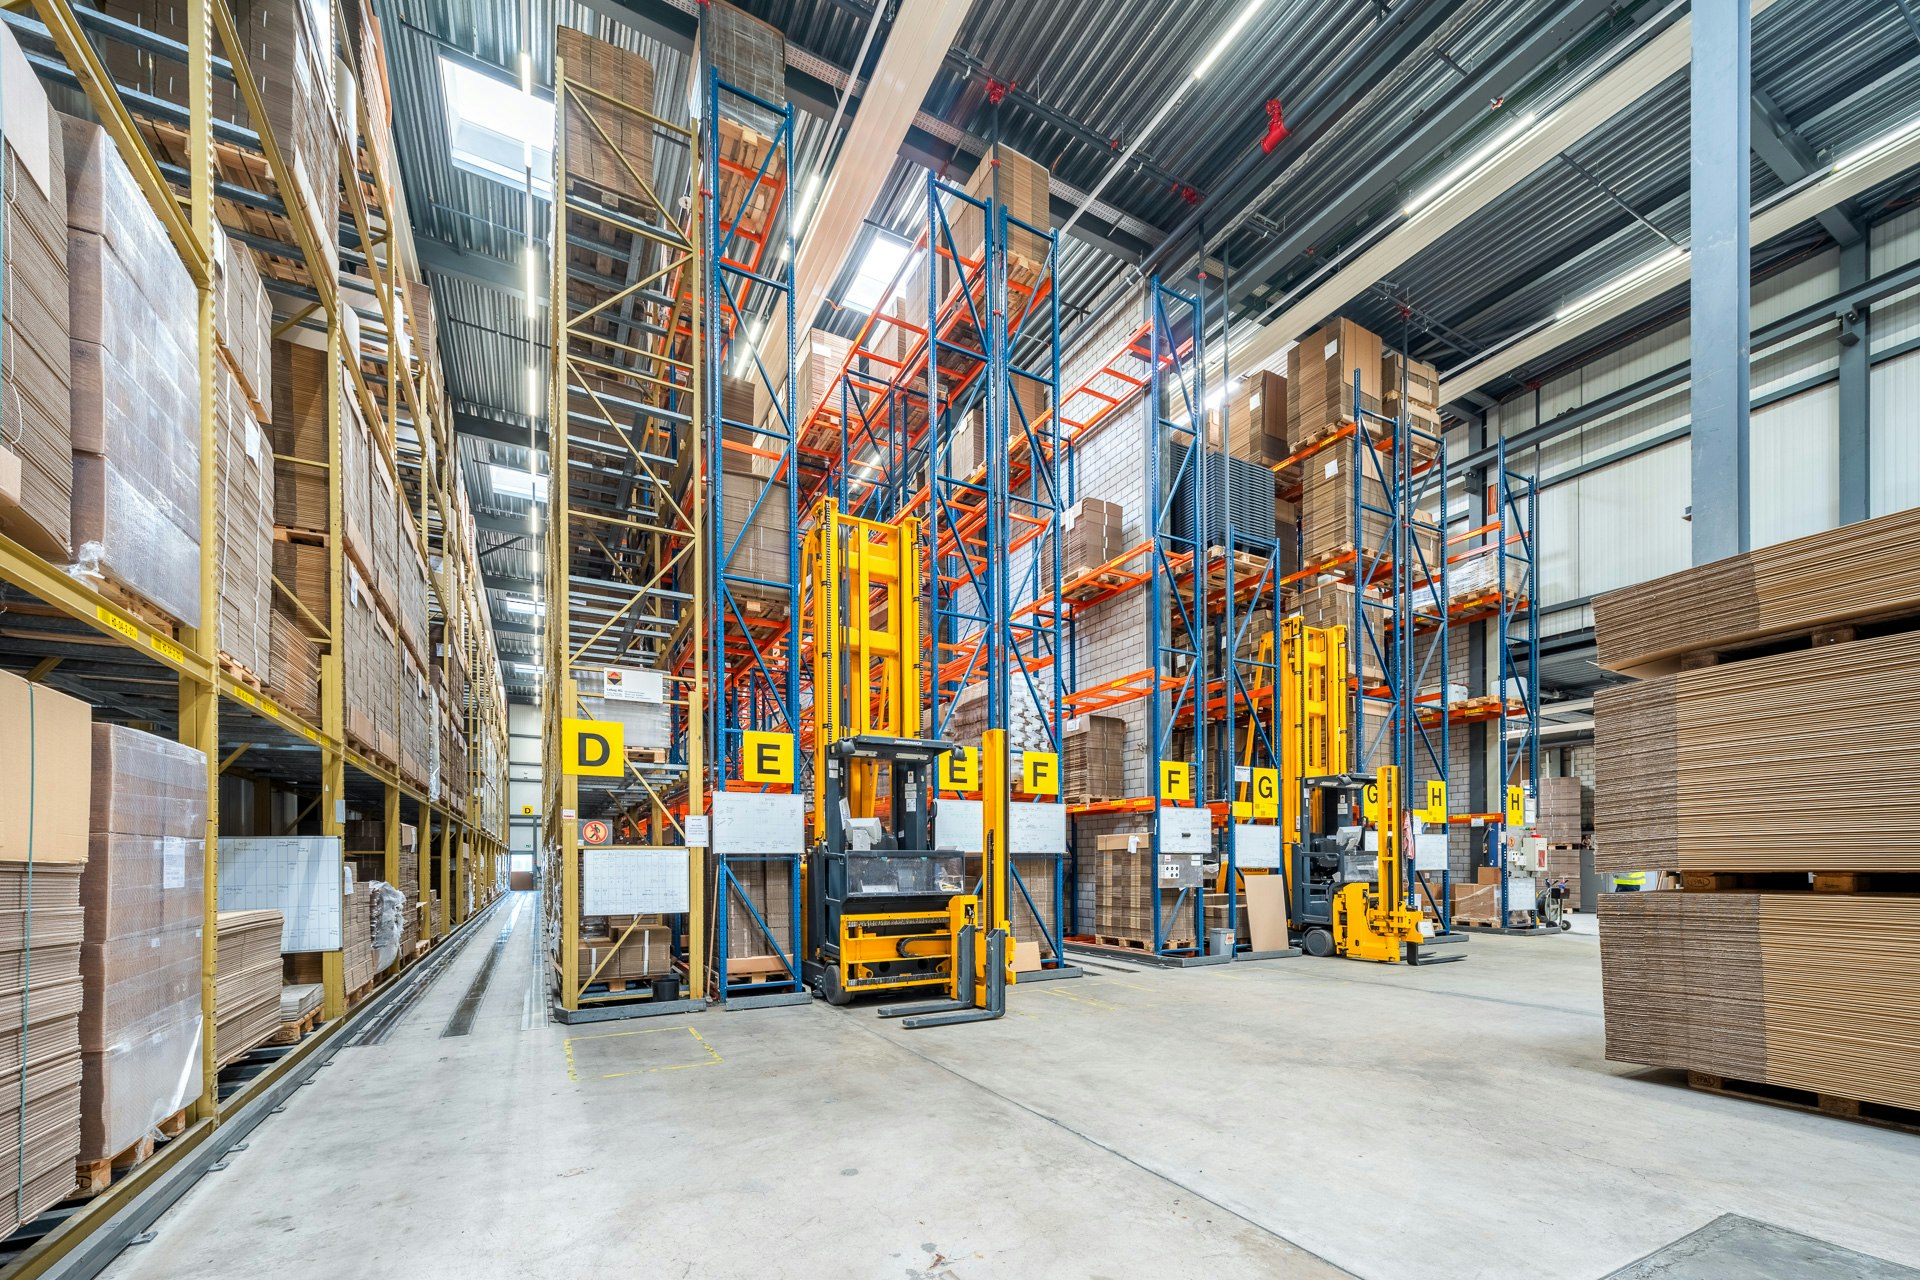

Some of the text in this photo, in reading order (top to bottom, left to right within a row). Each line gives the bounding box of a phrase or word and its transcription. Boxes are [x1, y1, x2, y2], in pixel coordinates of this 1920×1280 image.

[577, 732, 611, 767] D
[756, 743, 781, 776] E
[949, 756, 967, 783] E
[1032, 761, 1049, 787] F
[1167, 769, 1181, 794] F
[1258, 775, 1273, 799] G
[1367, 784, 1378, 803] G
[1431, 787, 1442, 806] H
[1511, 793, 1520, 811] H
